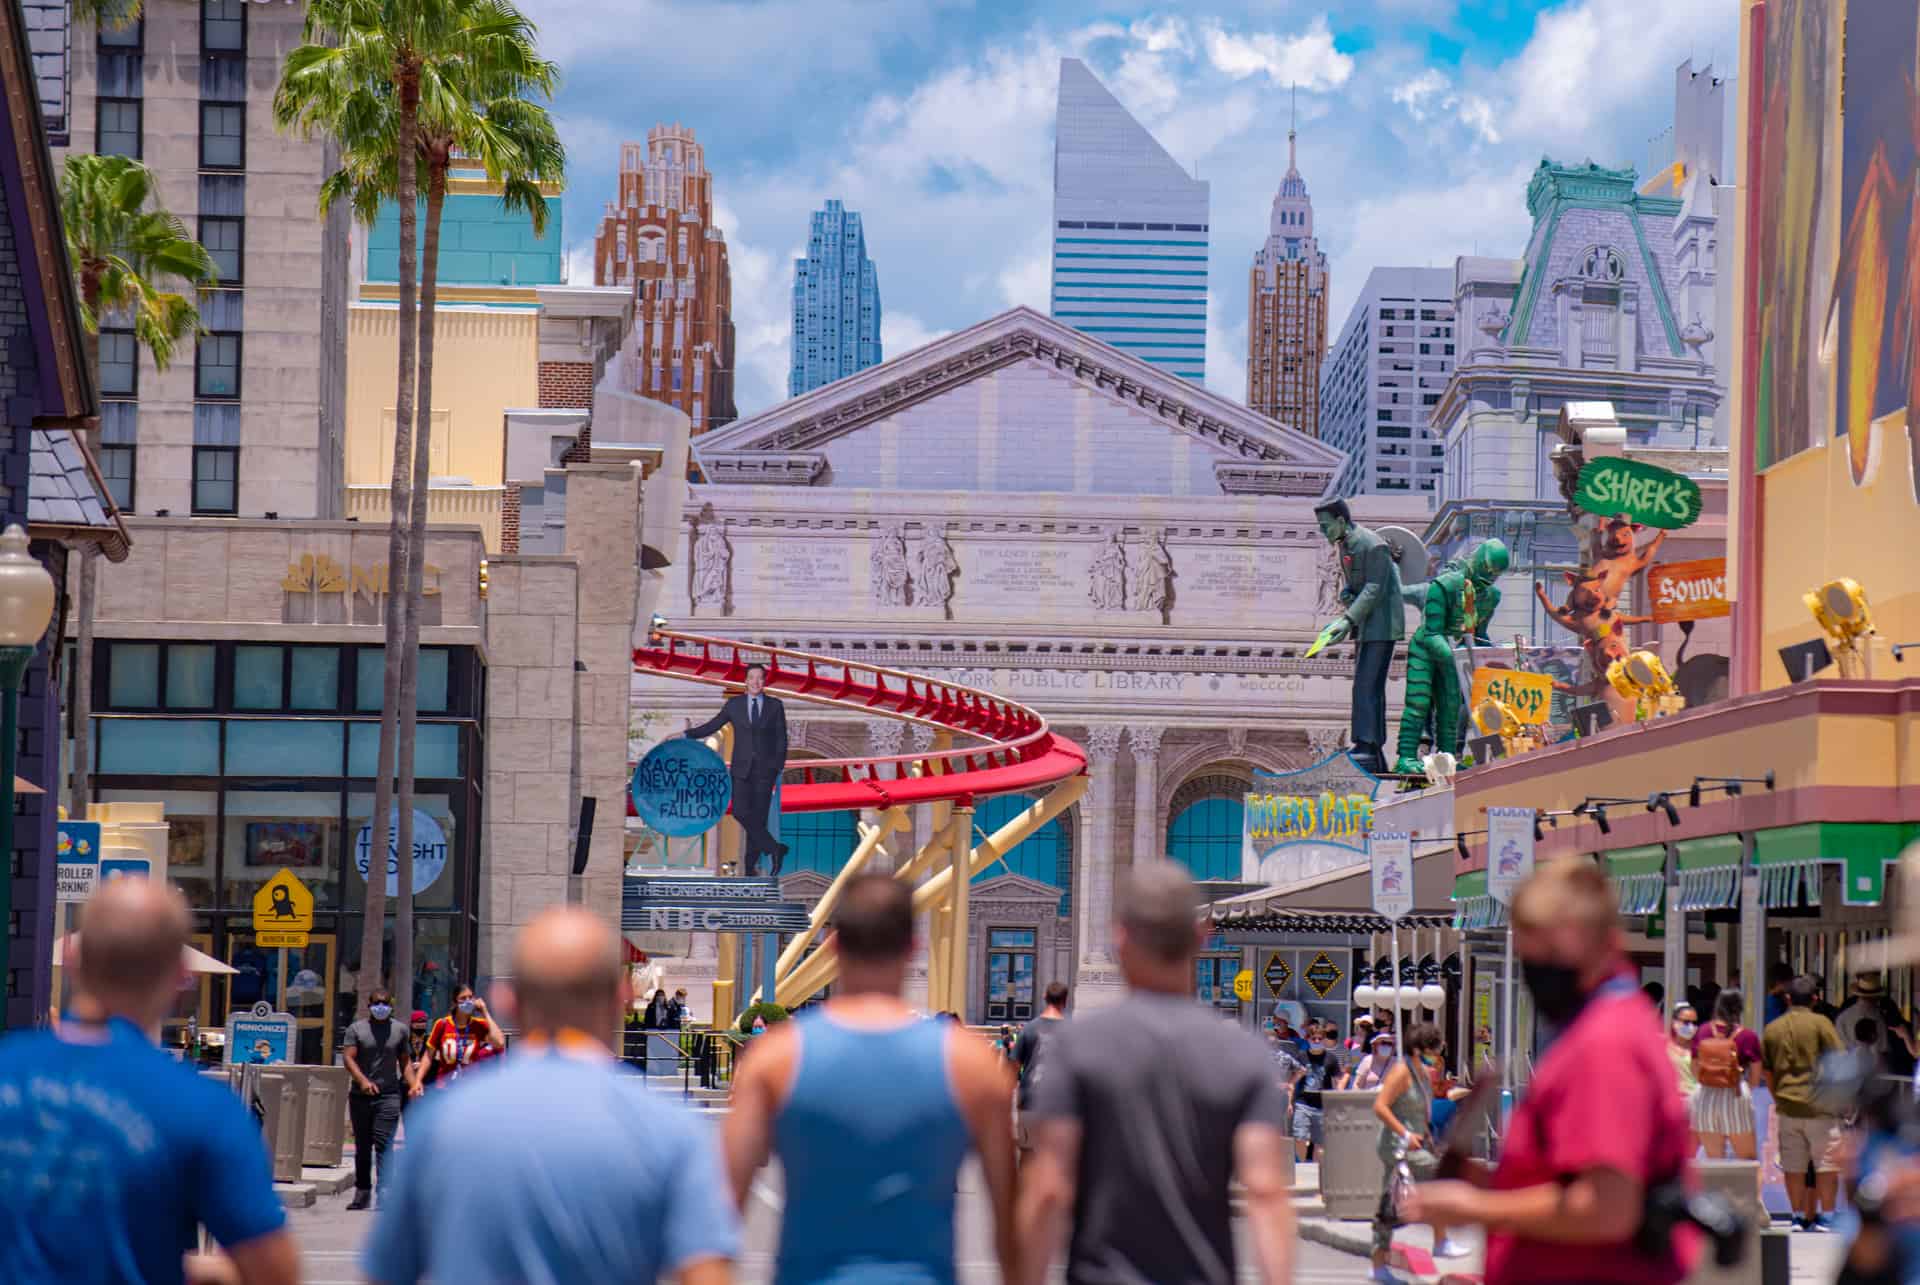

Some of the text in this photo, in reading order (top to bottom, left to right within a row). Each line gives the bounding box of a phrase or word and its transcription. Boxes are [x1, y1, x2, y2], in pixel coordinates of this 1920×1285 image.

[1585, 468, 1692, 520] SHREK'S
[1008, 672, 1084, 690] PUBLIC
[1094, 673, 1185, 691] LIBRARY
[641, 757, 689, 774] RACE
[640, 773, 729, 790] NEW YORK
[675, 788, 727, 807] JIMMY
[659, 800, 722, 819] FALLON
[360, 826, 397, 843] TE
[359, 843, 448, 860] TNGHT
[58, 867, 94, 880] ROLLER
[57, 881, 89, 894] ARKING
[636, 884, 664, 897] THE
[649, 910, 724, 931] NBC
